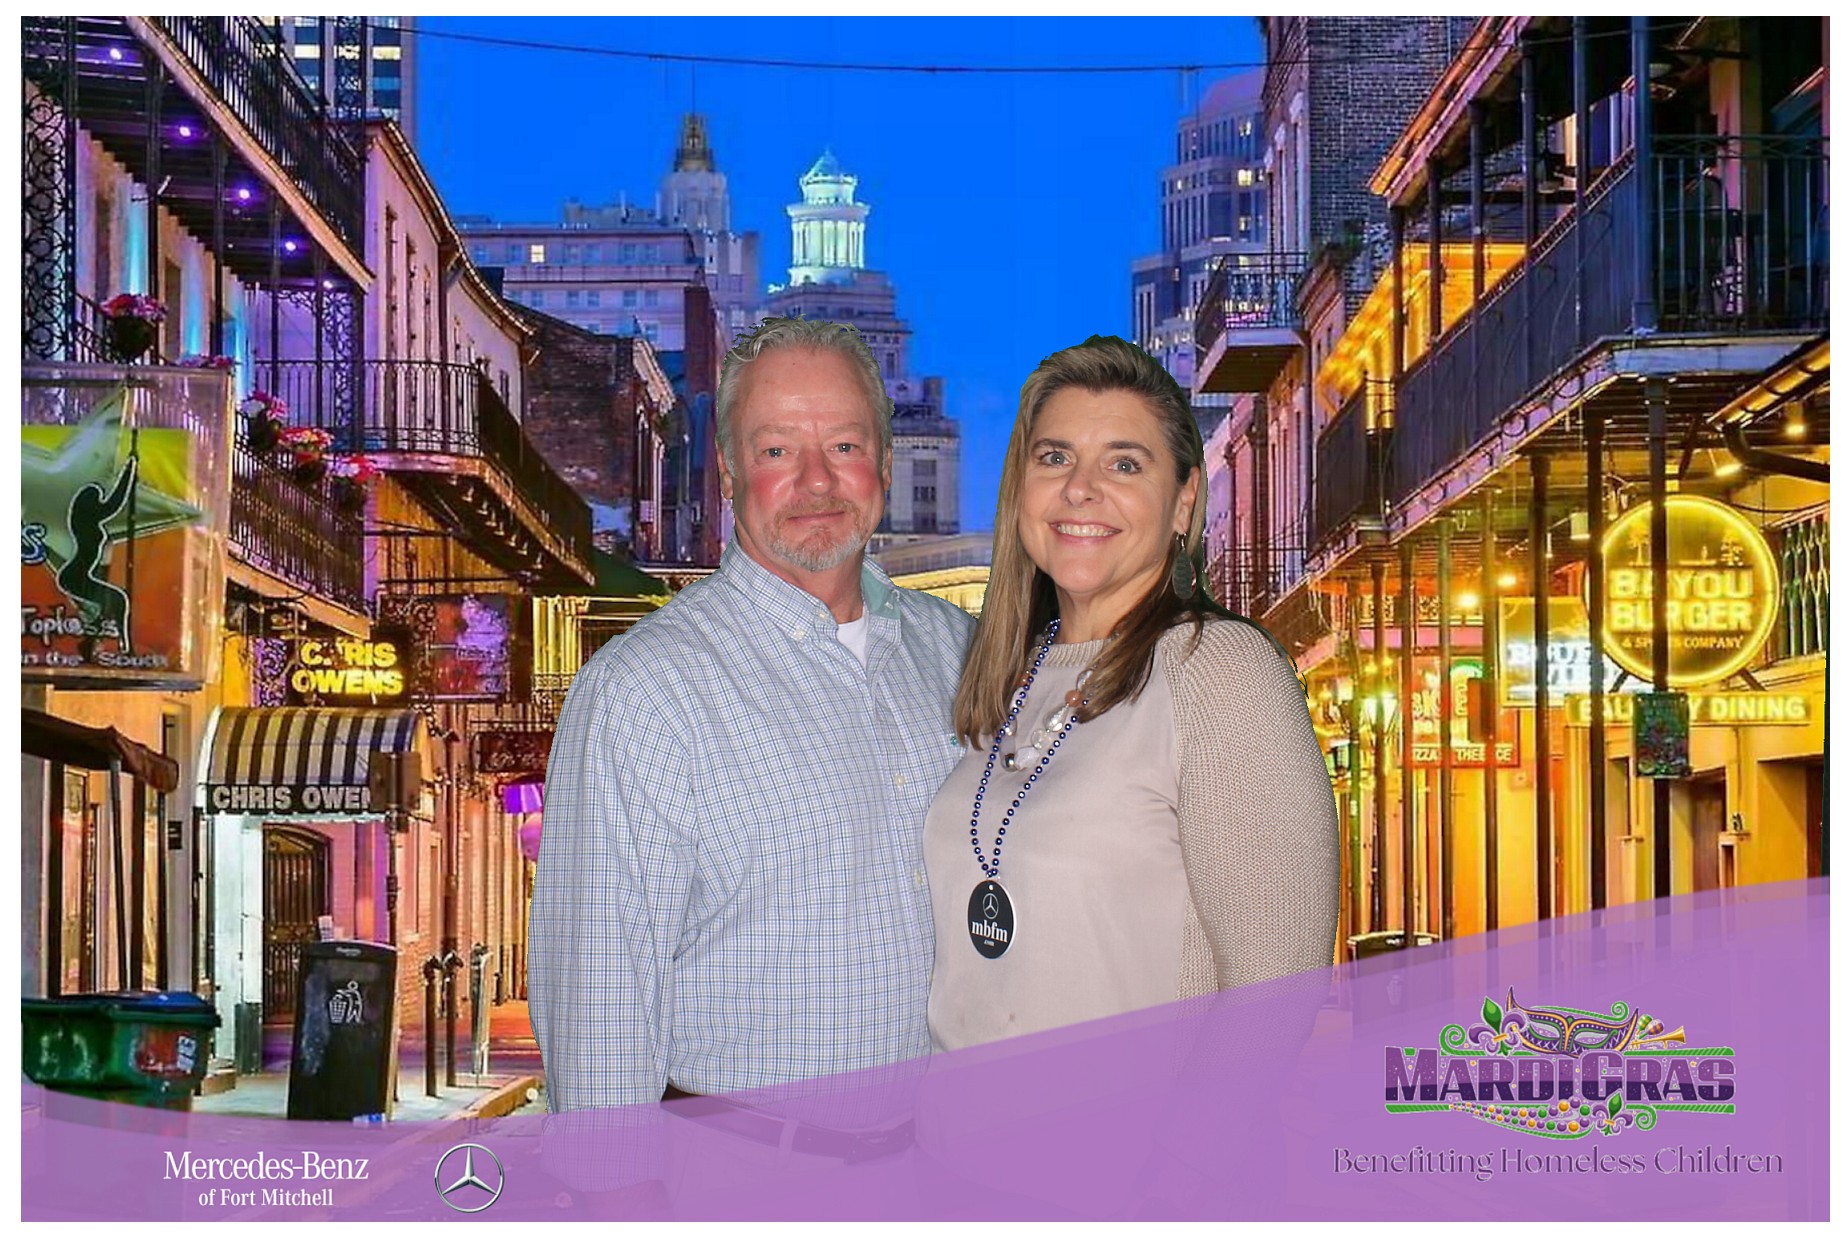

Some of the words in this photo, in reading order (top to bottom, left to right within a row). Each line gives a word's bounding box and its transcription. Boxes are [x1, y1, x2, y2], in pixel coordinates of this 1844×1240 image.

[1611, 600, 1753, 630] BURGER
[301, 641, 397, 667] CRIS
[1684, 636, 1744, 649] COMPANY
[292, 669, 403, 695] OWENS
[1710, 695, 1807, 720] DINING
[213, 786, 292, 810] CHRIS
[971, 919, 1008, 943] mbfm
